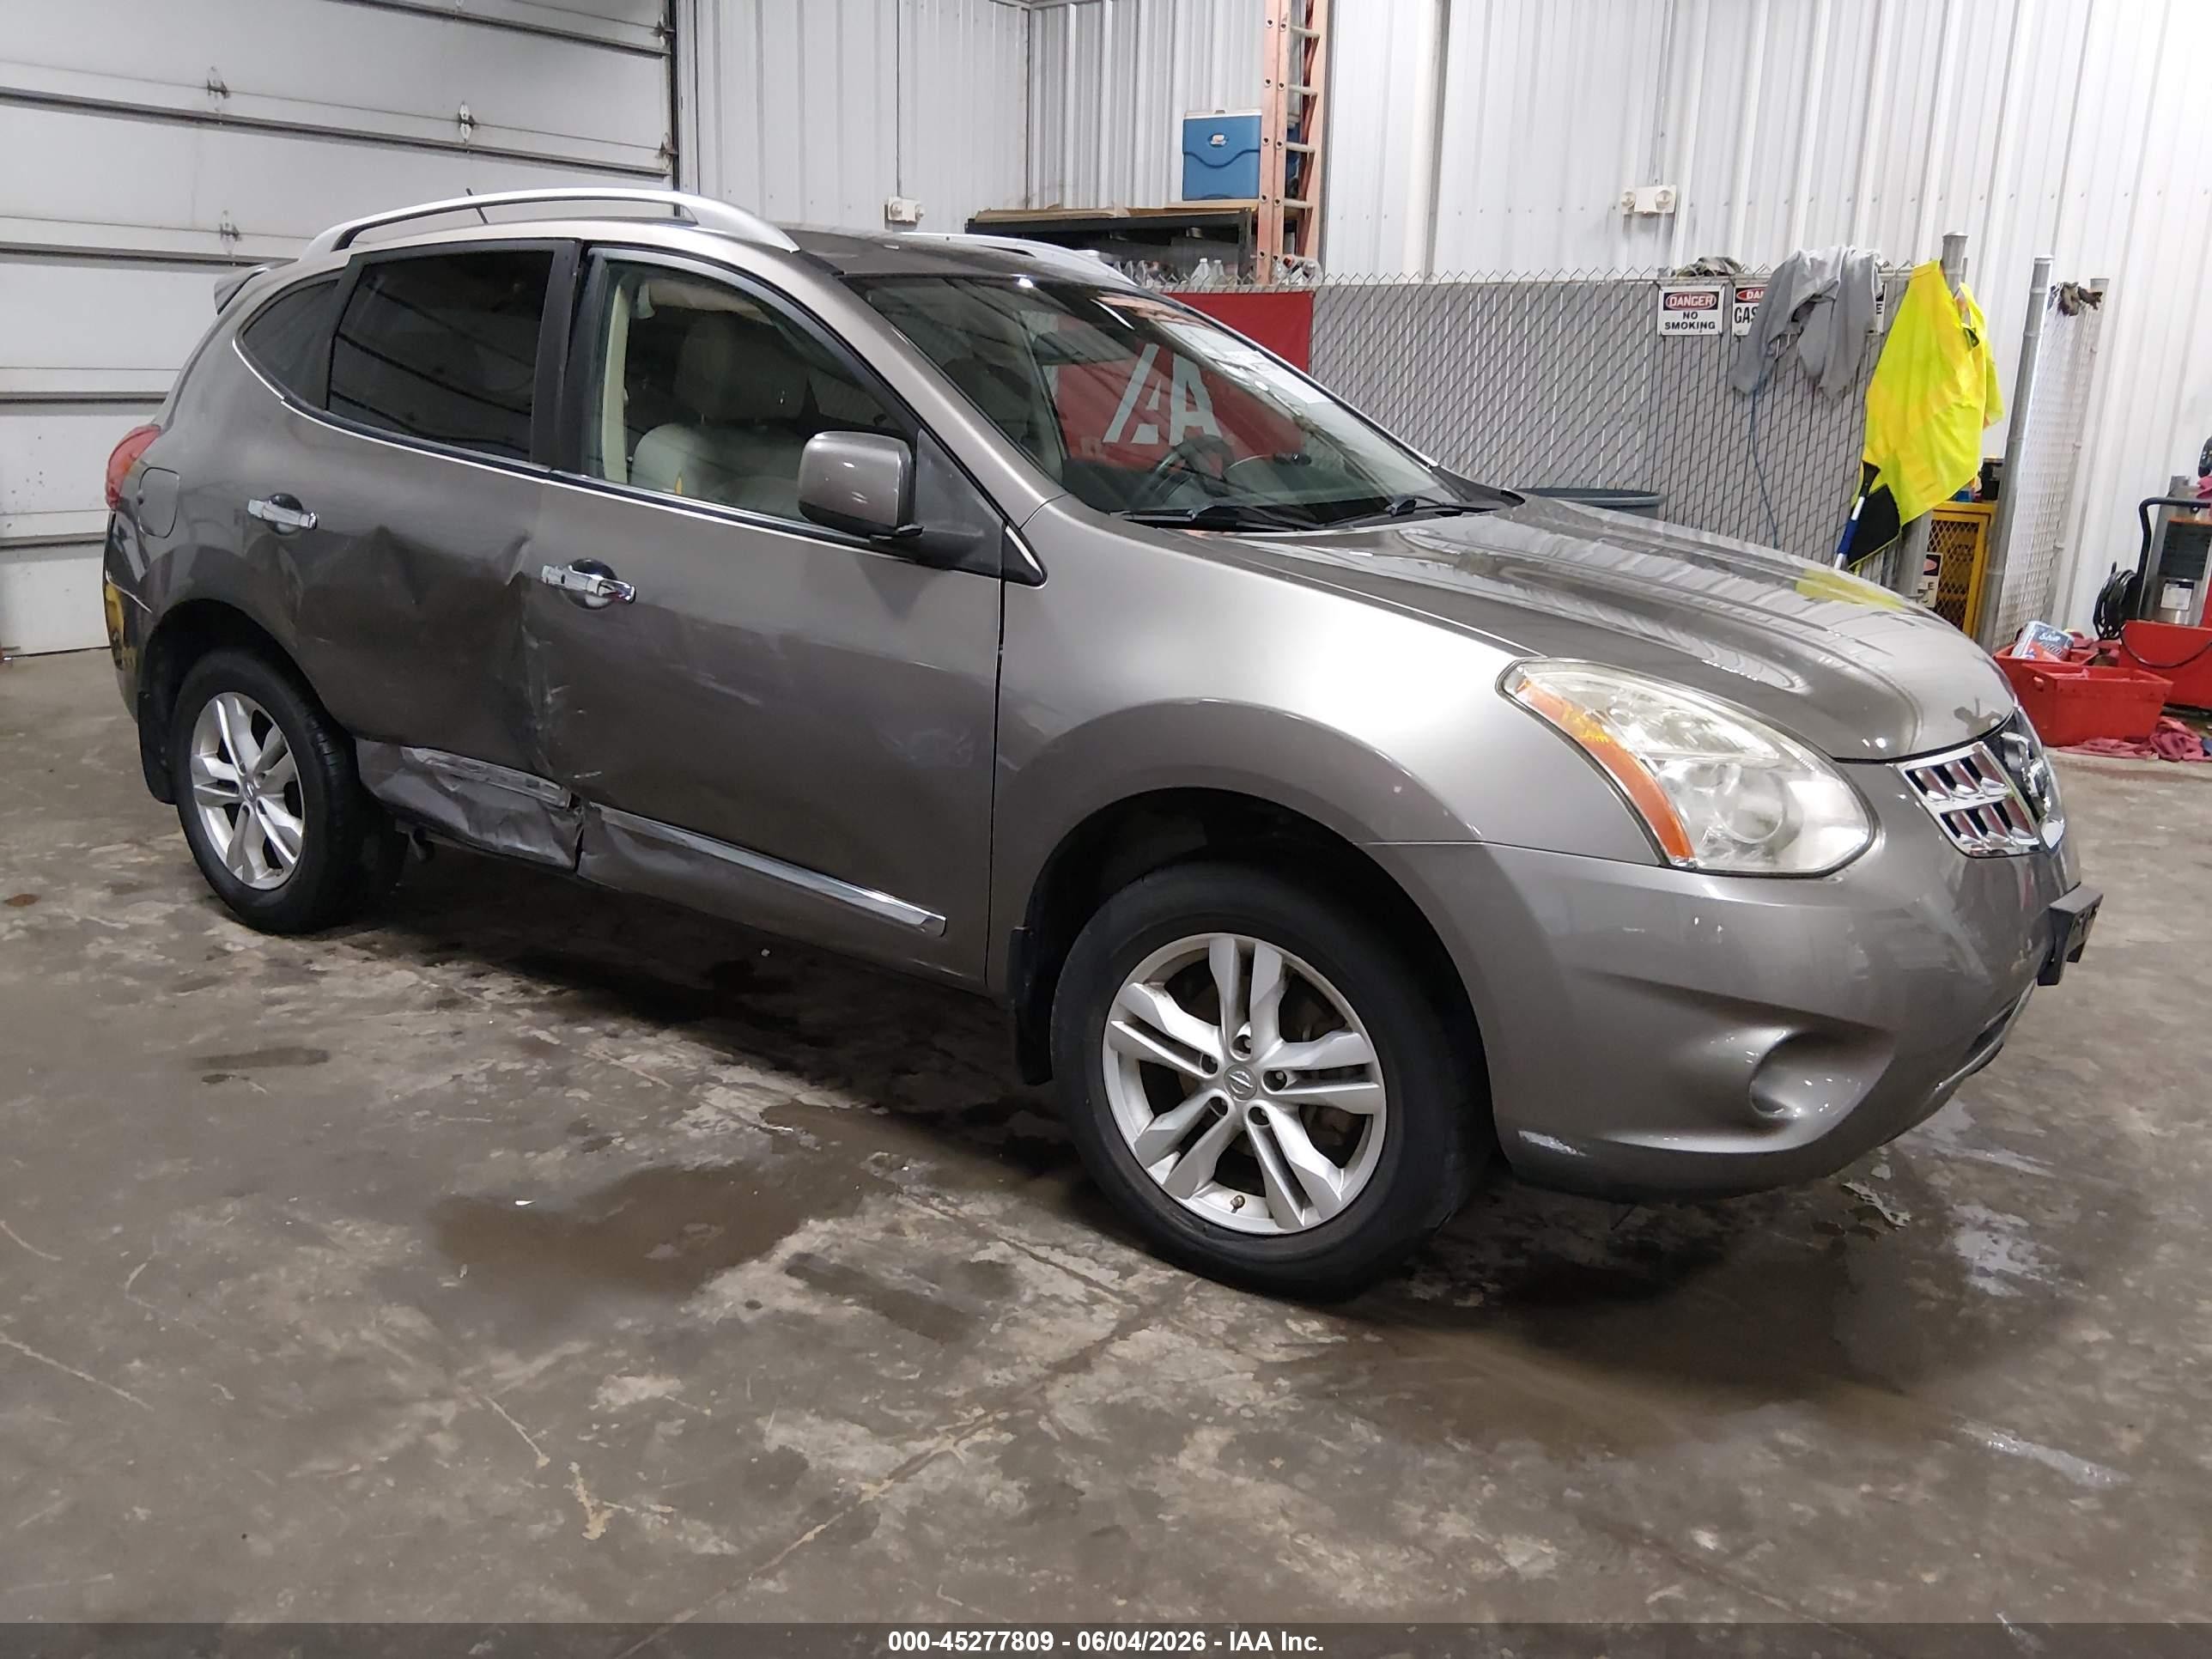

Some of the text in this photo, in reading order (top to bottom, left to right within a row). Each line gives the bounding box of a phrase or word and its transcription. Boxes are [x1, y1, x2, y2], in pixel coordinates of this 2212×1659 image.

[1668, 295, 1714, 307] DANGER
[1682, 311, 1698, 320] NO
[1664, 320, 1716, 331] SMOKING
